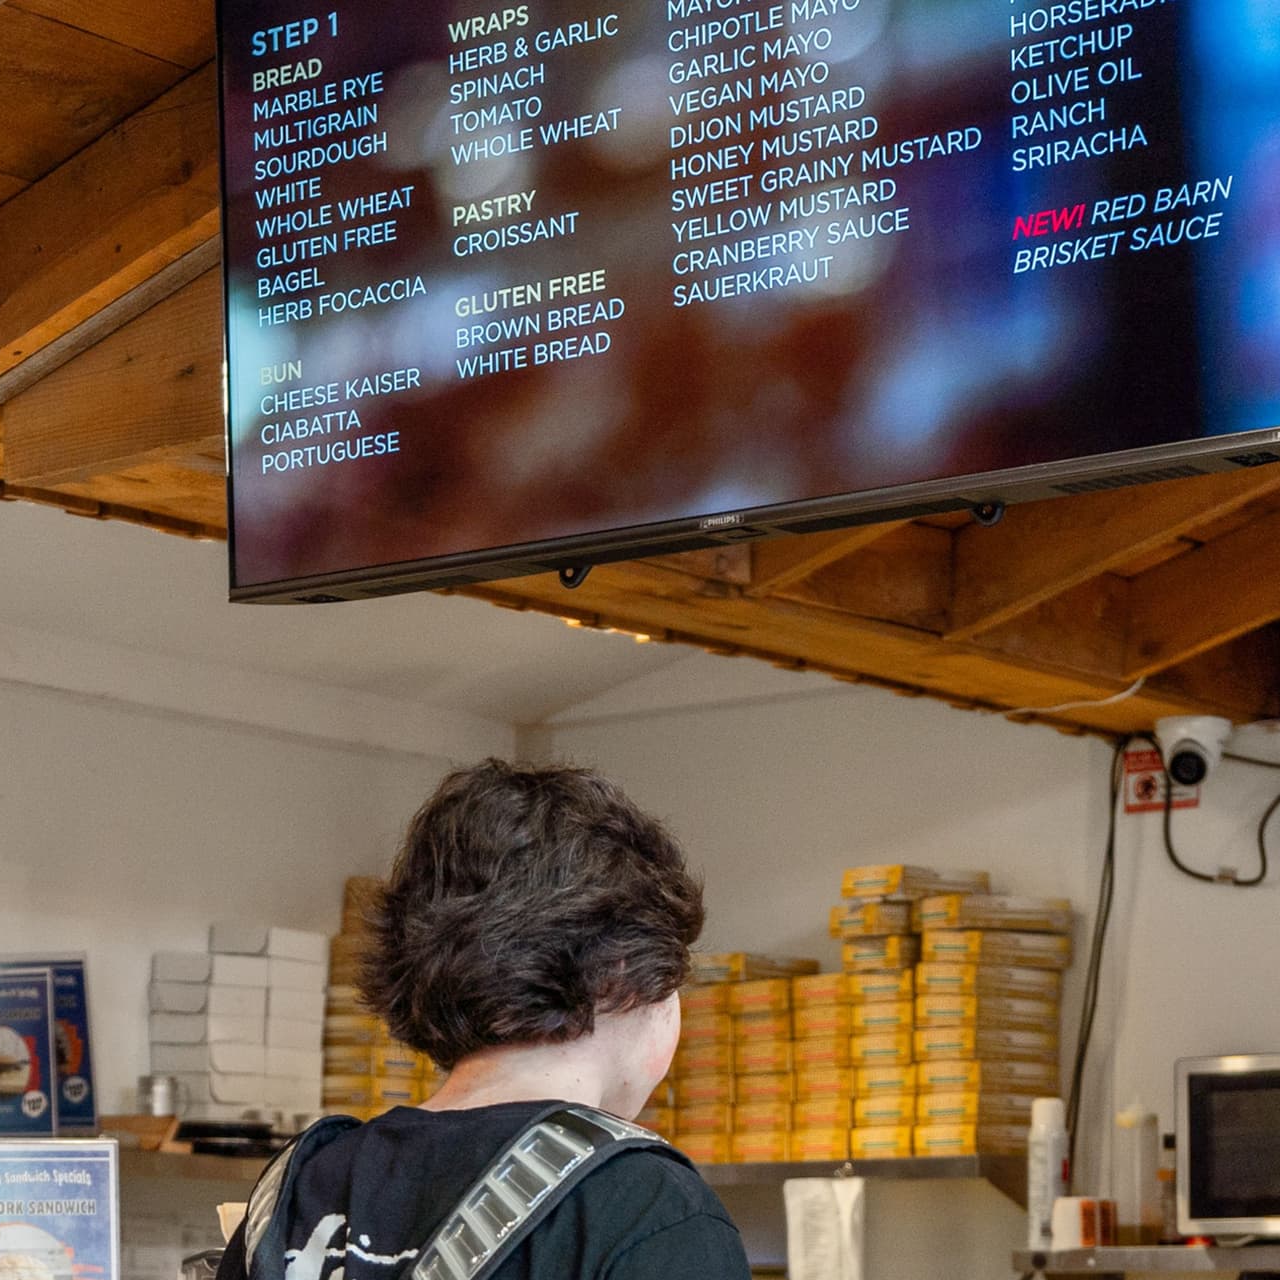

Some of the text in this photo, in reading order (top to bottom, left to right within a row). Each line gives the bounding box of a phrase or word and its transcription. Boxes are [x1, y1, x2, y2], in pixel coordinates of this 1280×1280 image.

[252, 12, 340, 57] STEP 1
[448, 7, 530, 43] WRAPS
[449, 14, 619, 74] HERB & GARLIC
[1009, 24, 1134, 71] KETCHUP
[252, 58, 323, 93] BREAD
[669, 28, 833, 86] GARLIC MAYO
[1010, 57, 1143, 105] OLIVE OIL
[253, 72, 384, 122] MARBLE RYE
[449, 64, 546, 105] SPINACH
[253, 104, 379, 152] MULTIGRAIN
[669, 85, 866, 150] DIJON MUSTARD
[253, 132, 389, 181] SOURDOUGH
[1012, 124, 1148, 173] SRIRACHA
[256, 186, 416, 240] WHOLE WHEAT
[452, 190, 537, 227] PASTRY
[1012, 174, 1233, 241] NEW! RED BARN
[256, 221, 398, 270] GLUTEN FREE
[453, 212, 580, 259] CROISSANT
[672, 206, 910, 276] CRANBERRY SAUCE
[1013, 212, 1223, 275] BRISKET SAUCE
[256, 268, 325, 300] BAGEL
[257, 276, 428, 329] HERB FOCACCIA
[673, 256, 834, 308] SAUERKRAUT
[455, 297, 626, 350] BROWN BREAD
[260, 368, 421, 416] CHEESE KAISER
[261, 432, 401, 475] PORTUGUESE
[28, 1200, 96, 1216] SANDWICH
